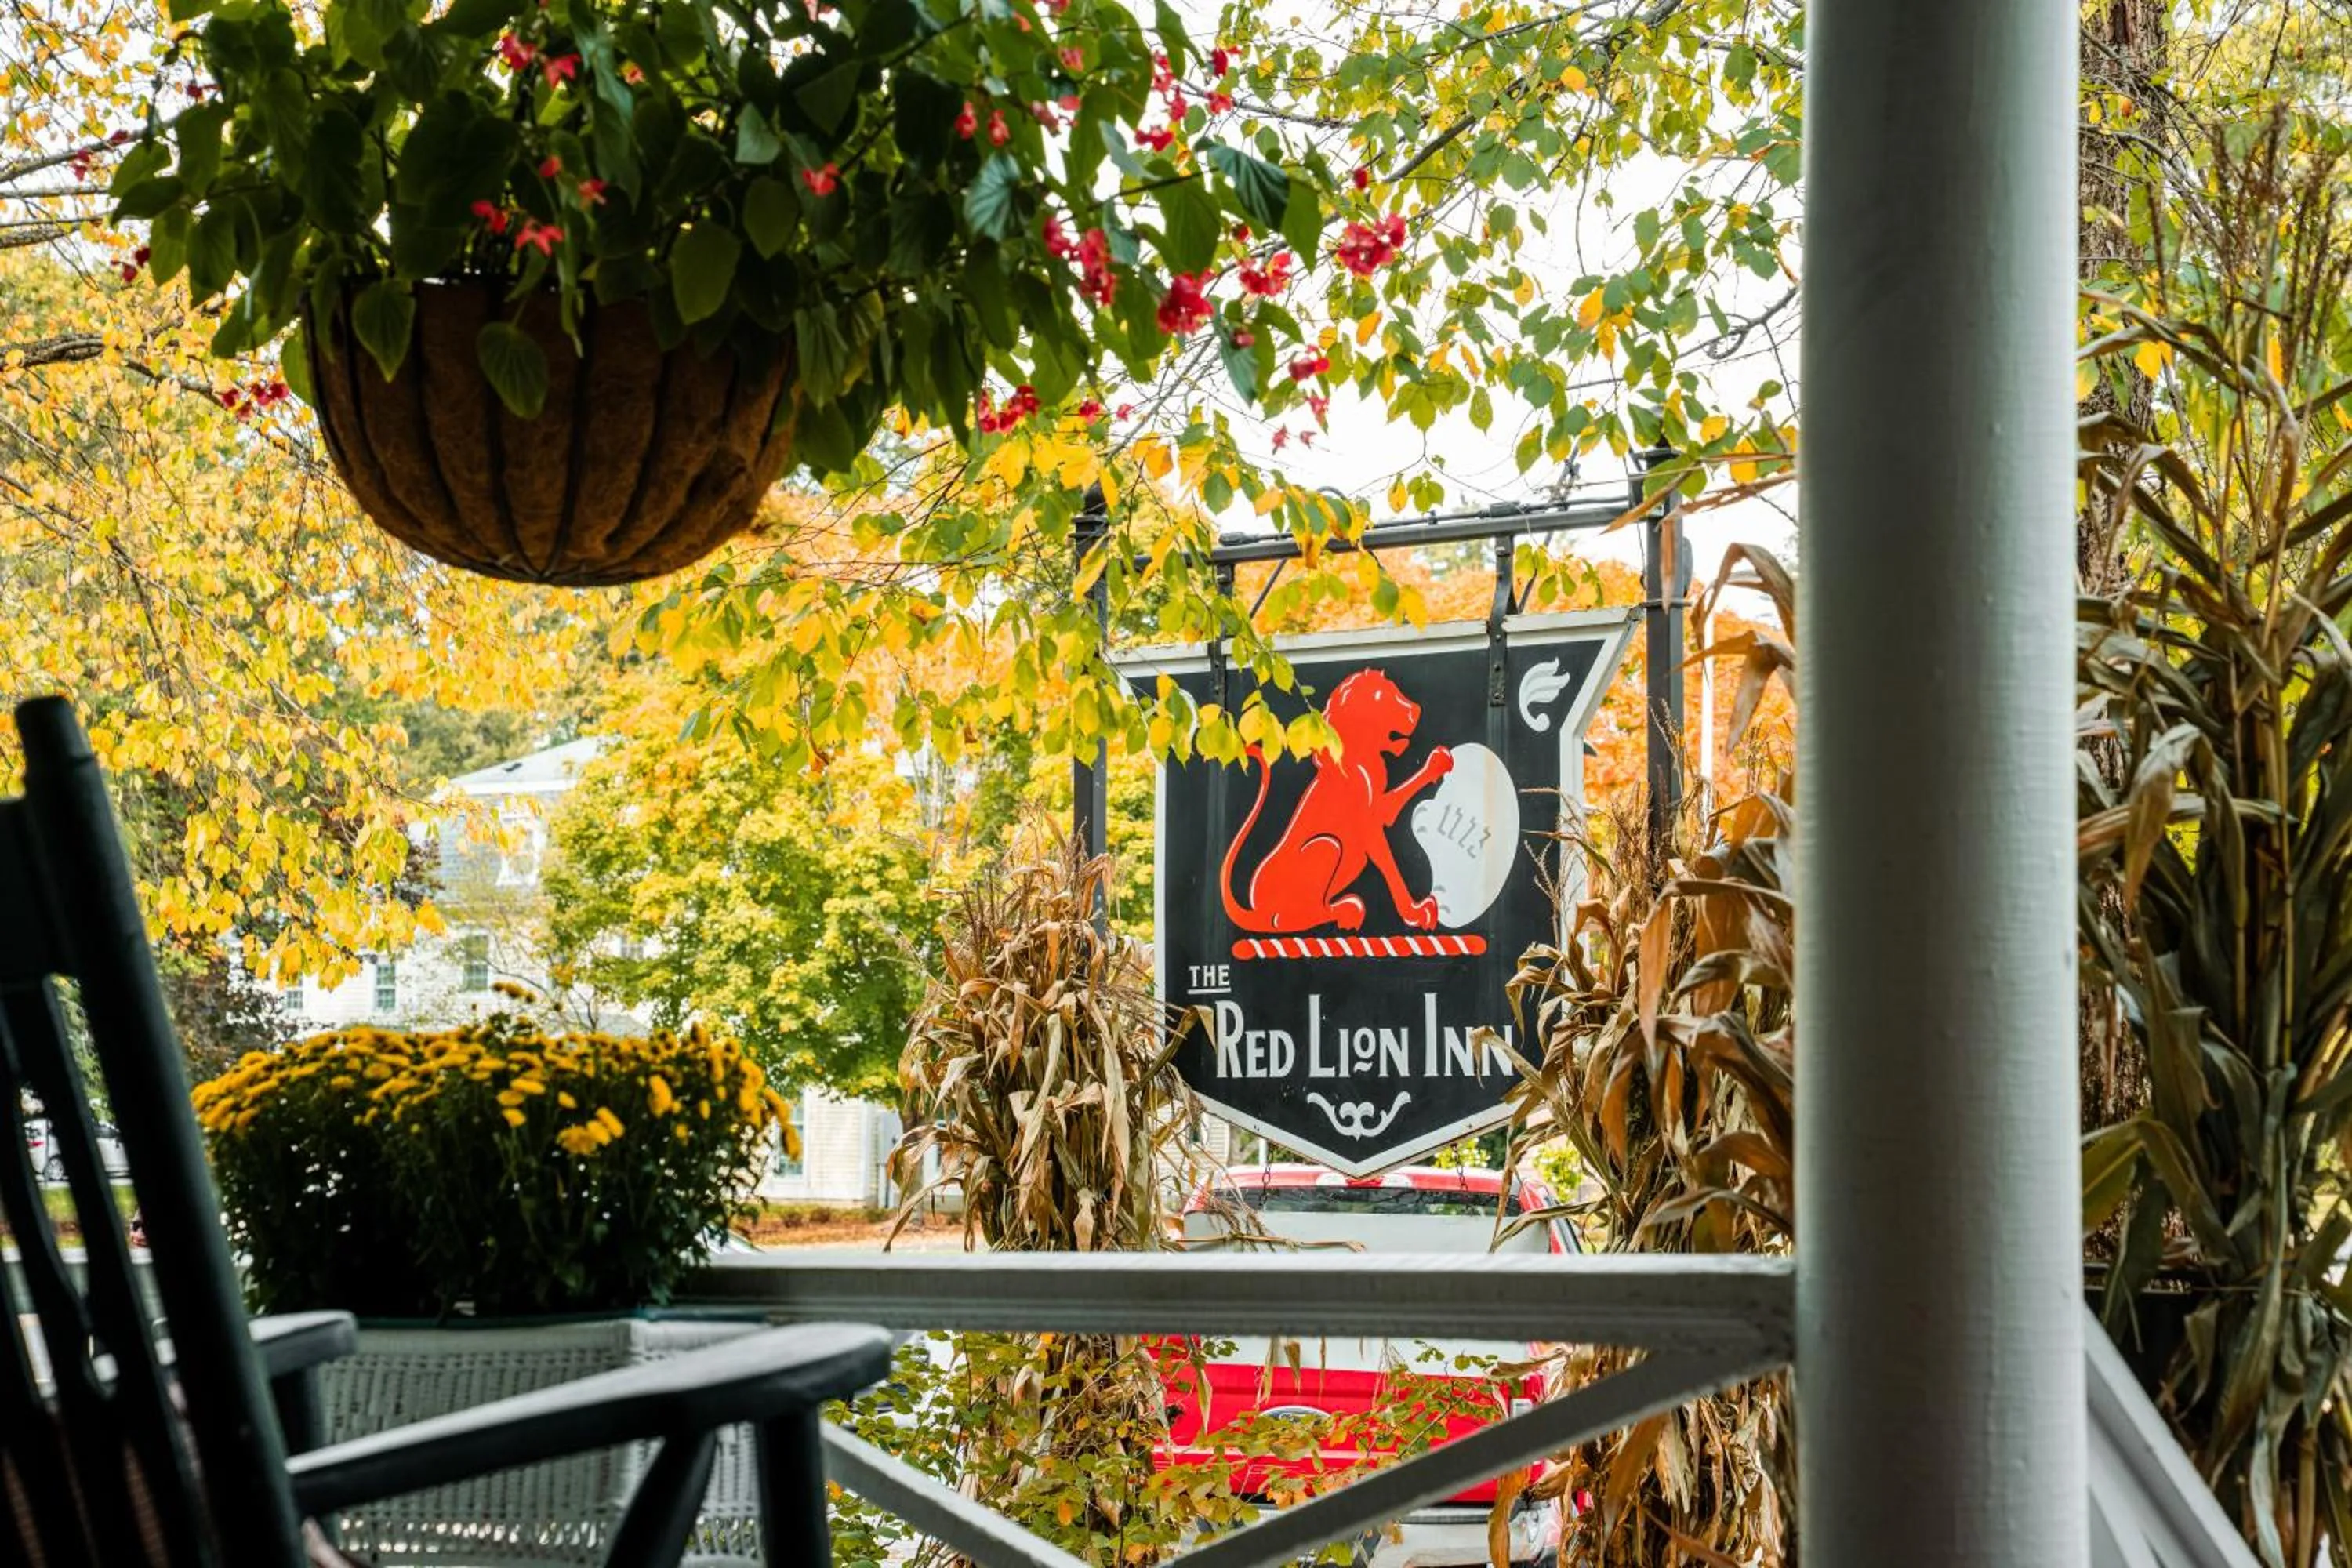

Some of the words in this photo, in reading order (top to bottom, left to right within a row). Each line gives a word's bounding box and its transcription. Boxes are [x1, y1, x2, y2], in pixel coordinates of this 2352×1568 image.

[1189, 964, 1230, 988] THE
[1215, 1000, 1296, 1079] RED
[1308, 993, 1410, 1078] LION
[1423, 992, 1514, 1077] INN
